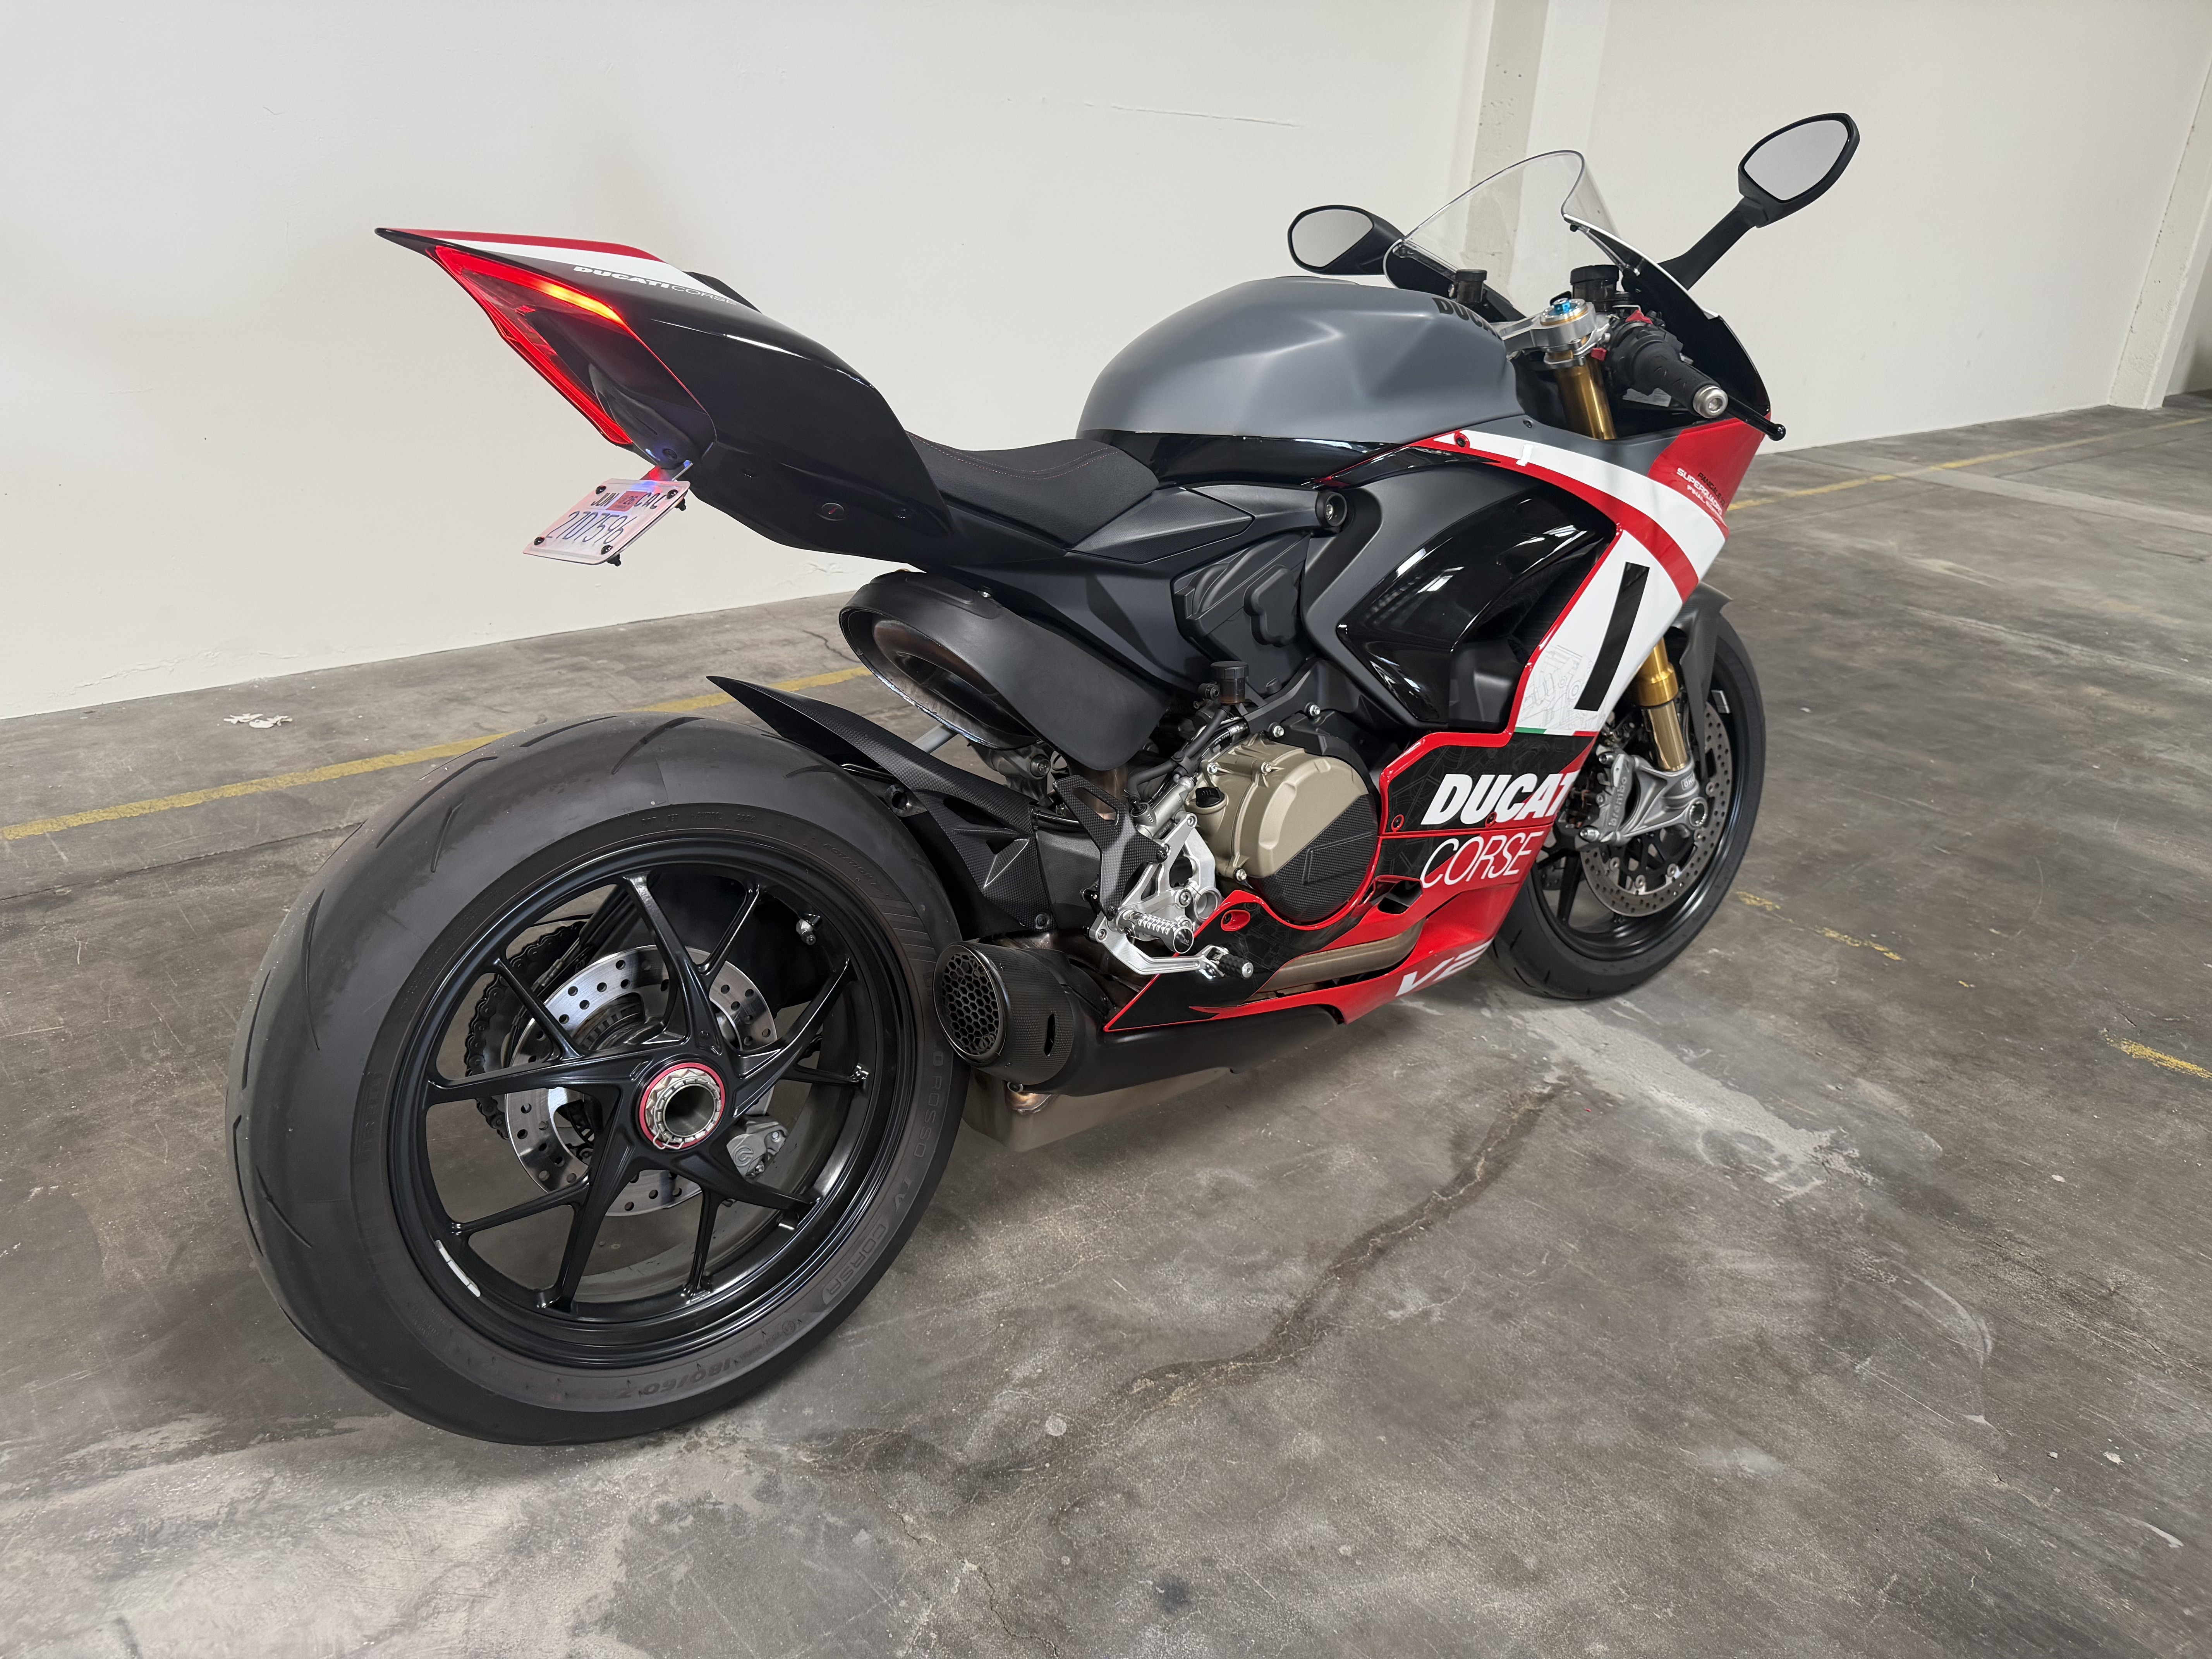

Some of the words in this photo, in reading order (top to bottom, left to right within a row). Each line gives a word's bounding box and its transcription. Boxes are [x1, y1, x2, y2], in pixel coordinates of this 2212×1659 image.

[573, 266, 670, 289] DUCATI
[1432, 297, 1502, 341] DUC
[591, 493, 620, 507] JUN
[634, 492, 666, 509] CAL
[1677, 467, 1722, 515] SUPERQUADRO
[1608, 777, 1626, 826] brembo
[1420, 831, 1544, 888] CORSE
[914, 1076, 943, 1159] ROSSO
[828, 1222, 887, 1294] CORSA
